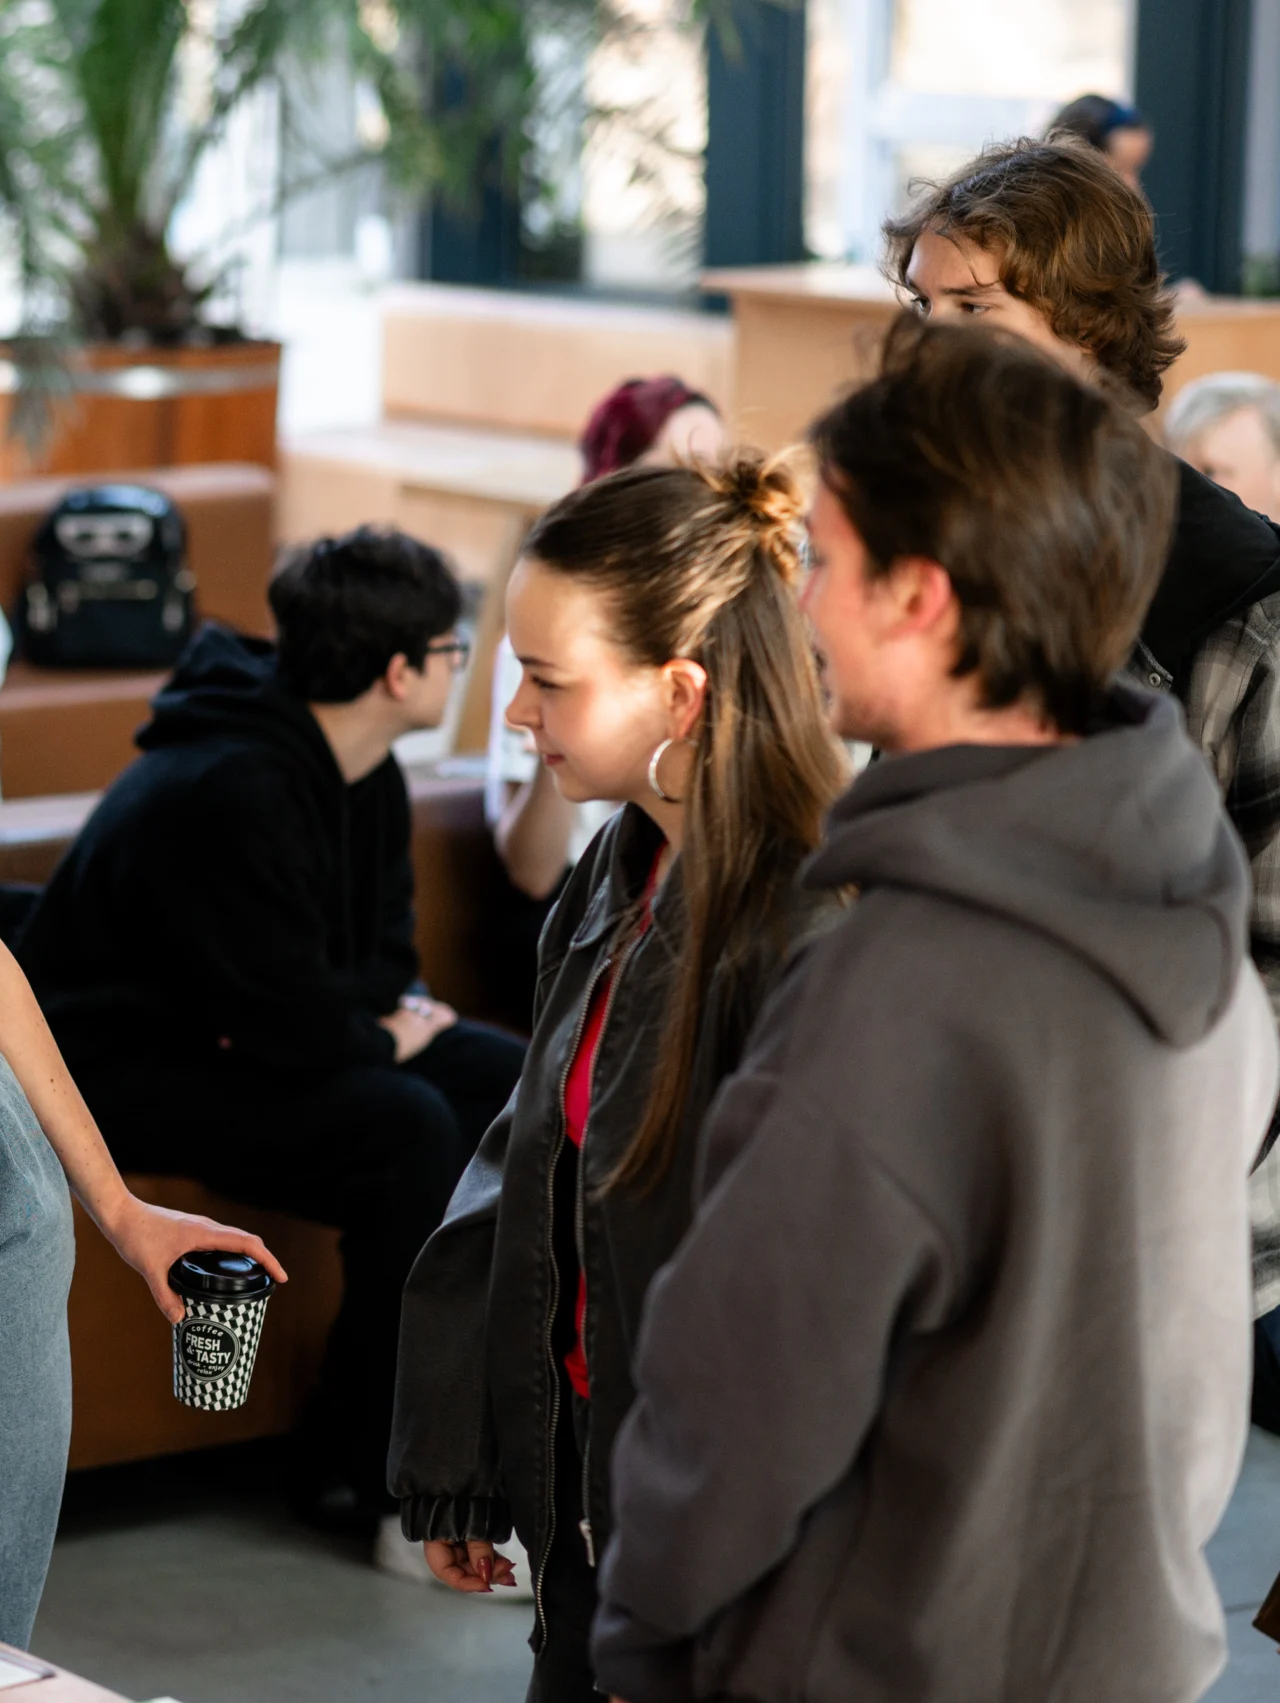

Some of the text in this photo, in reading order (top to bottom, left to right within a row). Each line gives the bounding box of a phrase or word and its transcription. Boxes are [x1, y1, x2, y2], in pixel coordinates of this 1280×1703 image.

[191, 1325, 224, 1336] coffee
[186, 1332, 220, 1351] FRESH
[187, 1346, 231, 1364] & TASTY
[187, 1359, 200, 1367] drink
